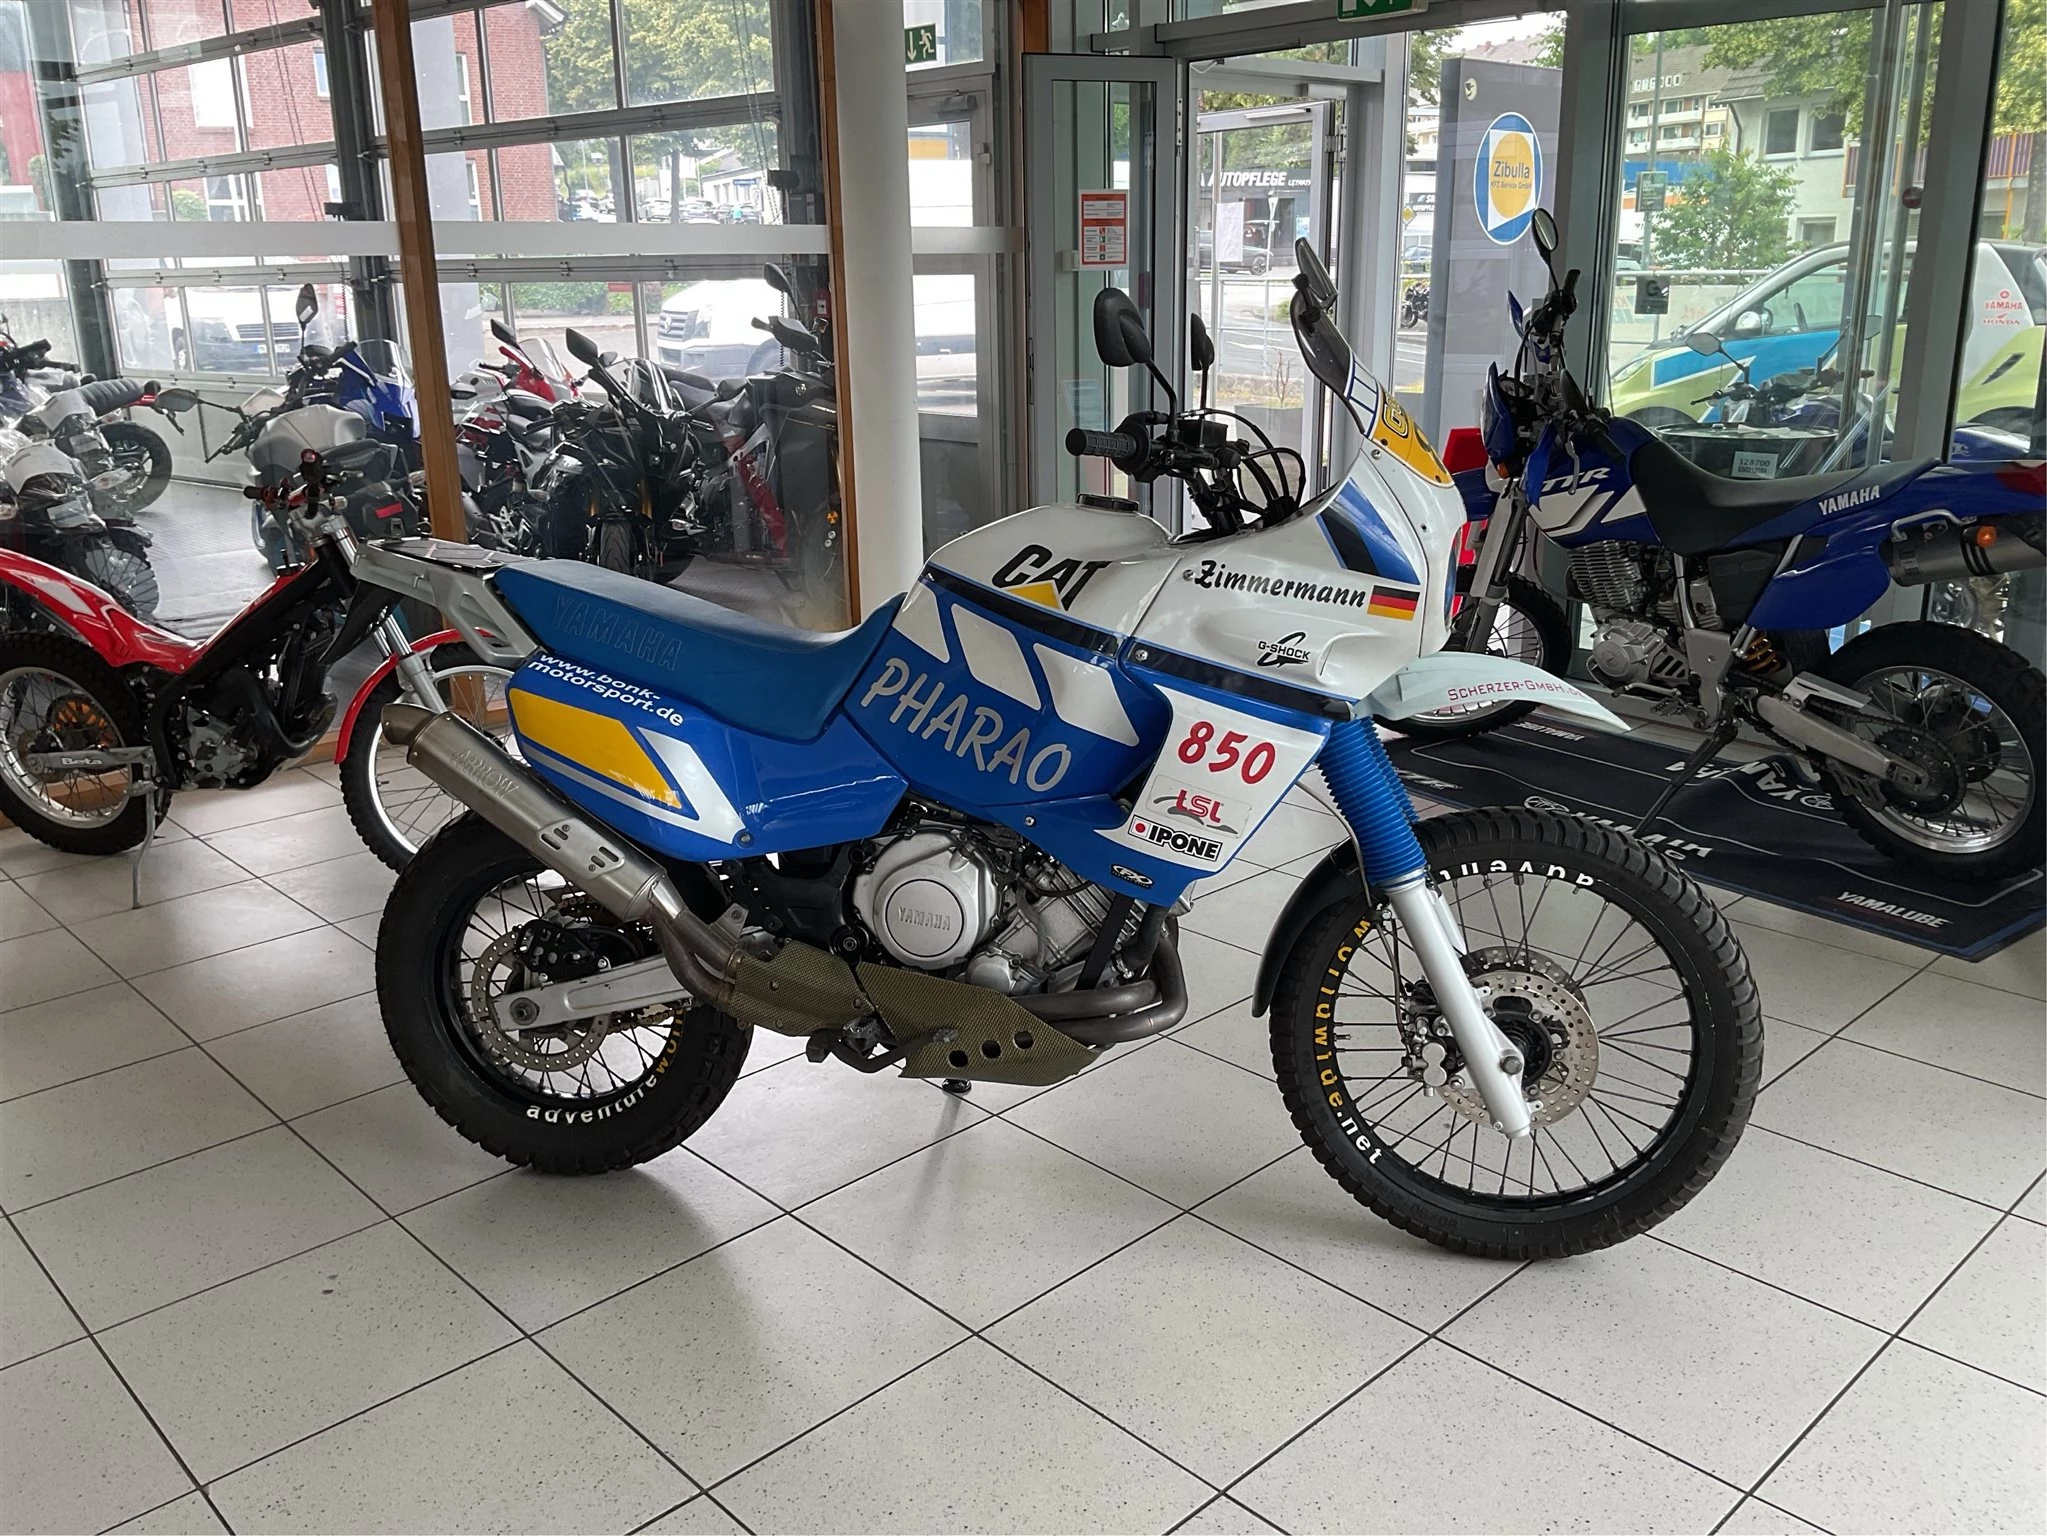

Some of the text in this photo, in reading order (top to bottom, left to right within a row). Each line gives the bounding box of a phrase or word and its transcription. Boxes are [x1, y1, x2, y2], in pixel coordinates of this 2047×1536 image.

[1494, 161, 1530, 179] Zibulla
[1985, 301, 2023, 310] YAMAHA
[1818, 485, 1880, 516] YAMAHA
[991, 544, 1113, 612] CAT
[1194, 558, 1366, 608] Zimmermann
[553, 594, 683, 672] YAMAHA
[1258, 640, 1311, 661] G-SHOCK
[528, 661, 684, 726] motorsport.de
[539, 654, 661, 700] www.bonk-
[860, 657, 1072, 792] PHARAO
[61, 757, 103, 765] Beta
[1178, 721, 1275, 784] 850
[450, 750, 519, 798] ARROW
[1175, 789, 1222, 824] LSL
[1148, 824, 1220, 860] IPONE
[898, 906, 951, 931] YAMAHA
[1837, 891, 1950, 928] YAMALUBE
